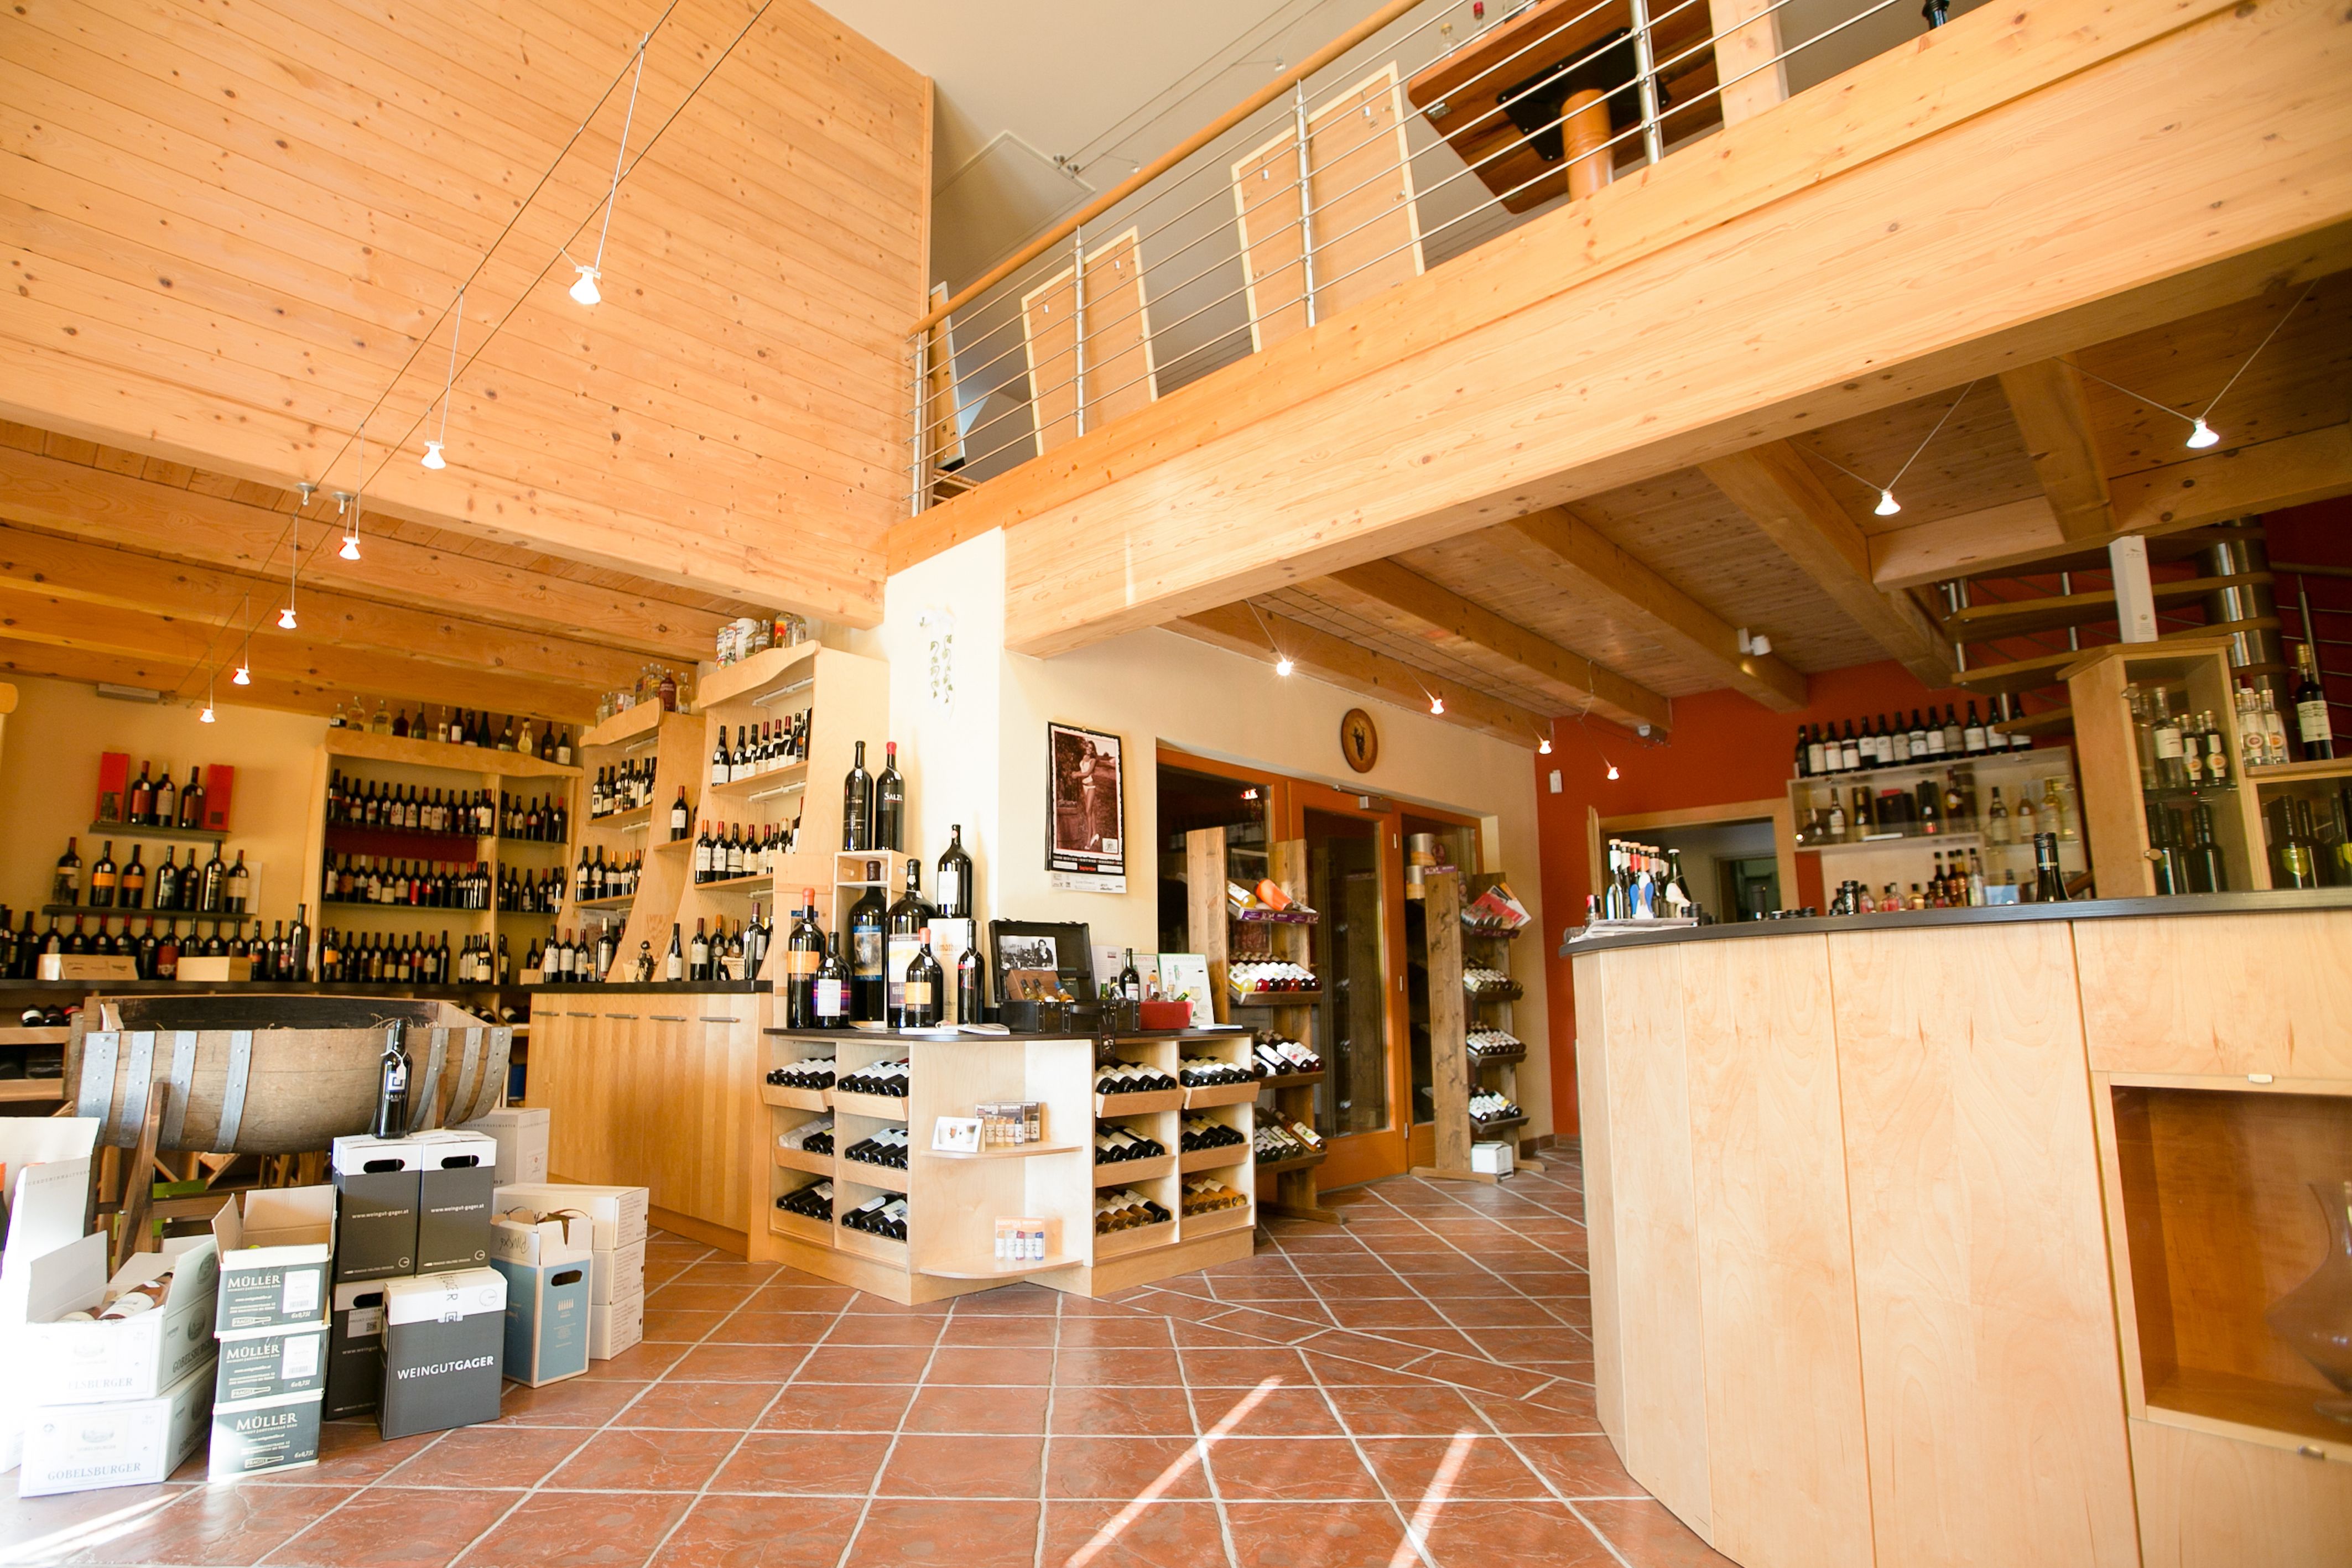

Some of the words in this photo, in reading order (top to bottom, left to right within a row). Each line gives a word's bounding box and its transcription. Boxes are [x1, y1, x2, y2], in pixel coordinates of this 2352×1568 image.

[884, 792, 903, 801] SALZL
[352, 1208, 409, 1218] www.weingut-gager.at
[431, 1204, 485, 1213] www.weingut-gager.at
[227, 1274, 281, 1289] MÜLLER
[226, 1343, 280, 1360] MÜLLER
[342, 1345, 379, 1355] www.weingut-
[397, 1356, 494, 1380] WEINGUTGAGER
[68, 1377, 133, 1390] ELSBURGER
[236, 1412, 298, 1431] MÜLLER
[294, 1450, 314, 1458] 6x0,75l
[48, 1462, 141, 1481] GOBELSBURGER
